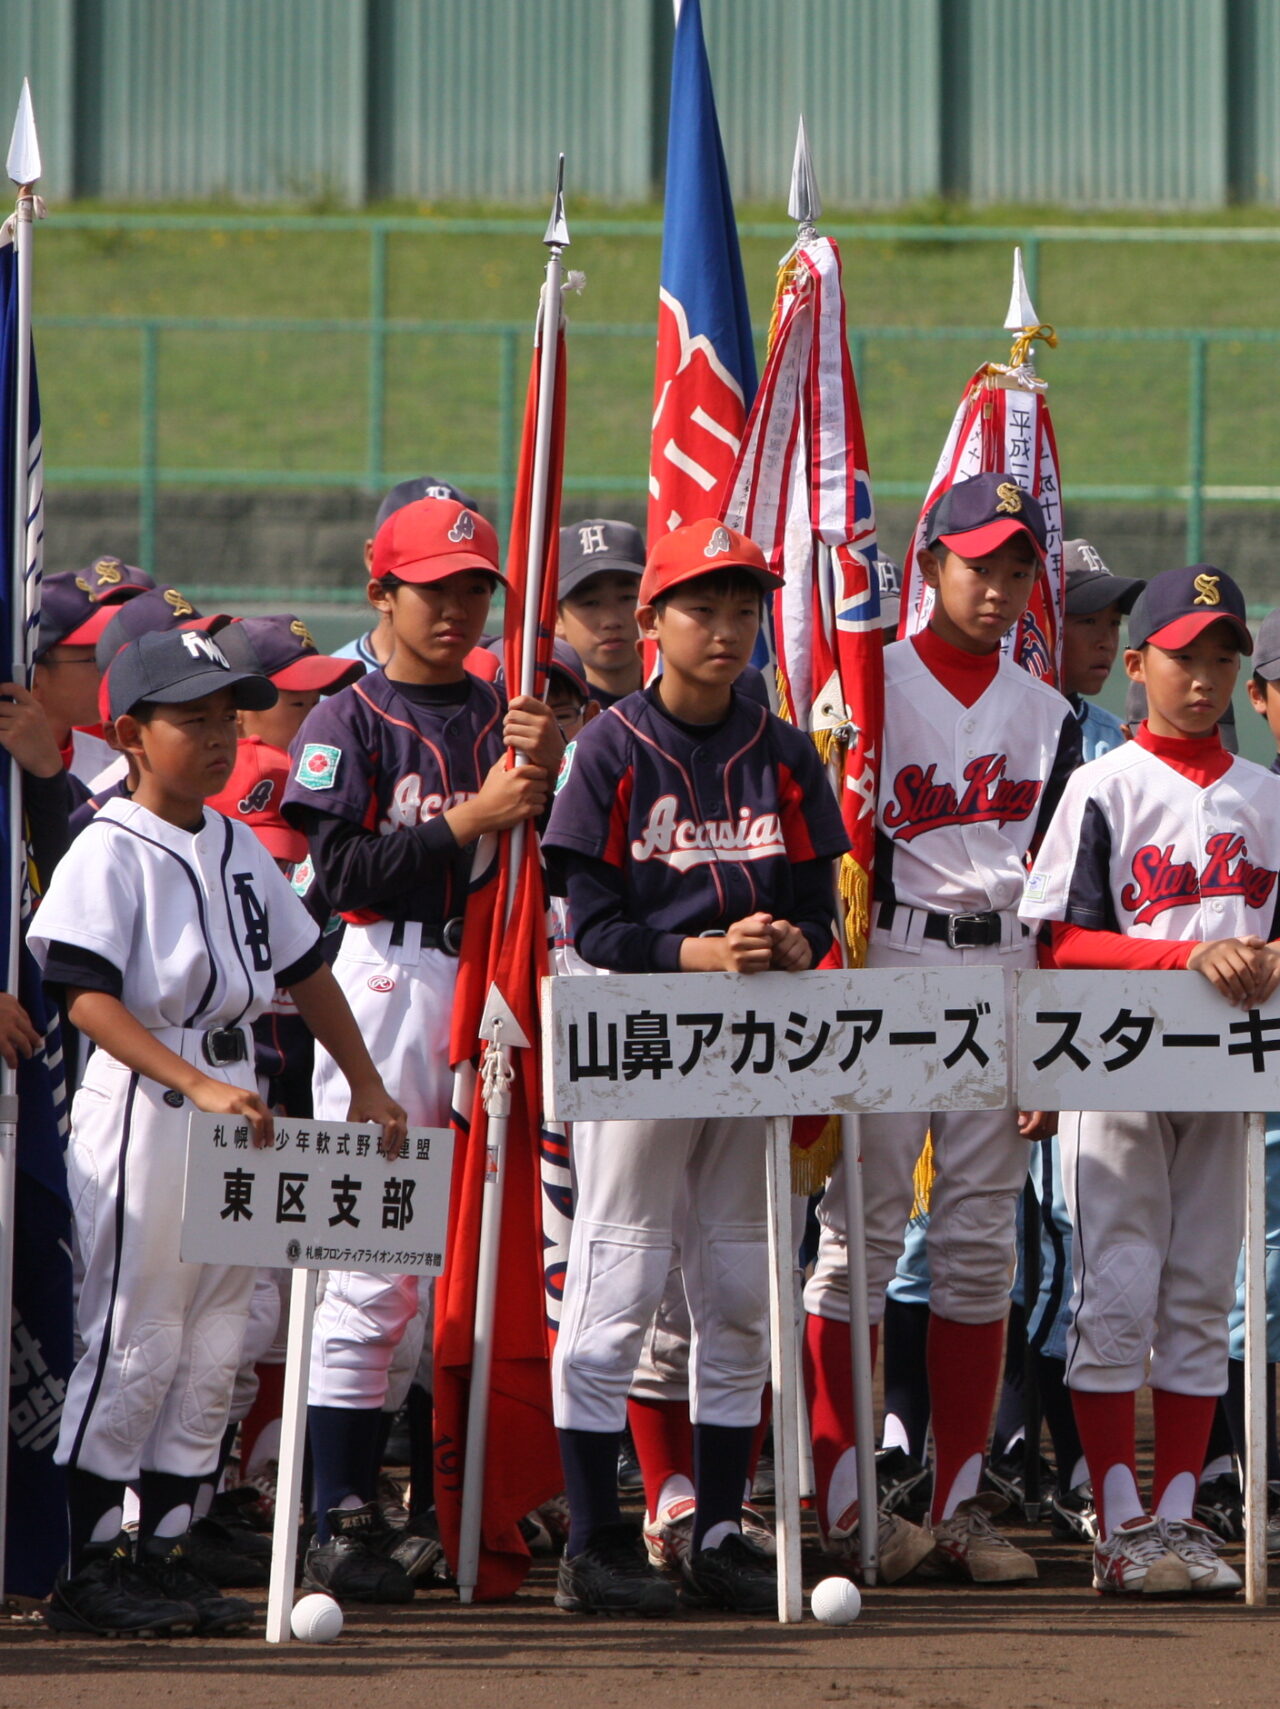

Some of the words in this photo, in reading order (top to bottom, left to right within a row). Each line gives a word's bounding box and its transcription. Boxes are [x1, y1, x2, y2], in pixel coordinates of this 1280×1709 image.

[996, 482, 1022, 513] S
[447, 509, 475, 543] A
[579, 525, 609, 555] H
[703, 526, 730, 557] A
[1193, 573, 1220, 606] S
[238, 779, 275, 814] A
[568, 1001, 991, 1083] 山鼻アカシアーズ
[219, 1167, 416, 1231] 東区支部
